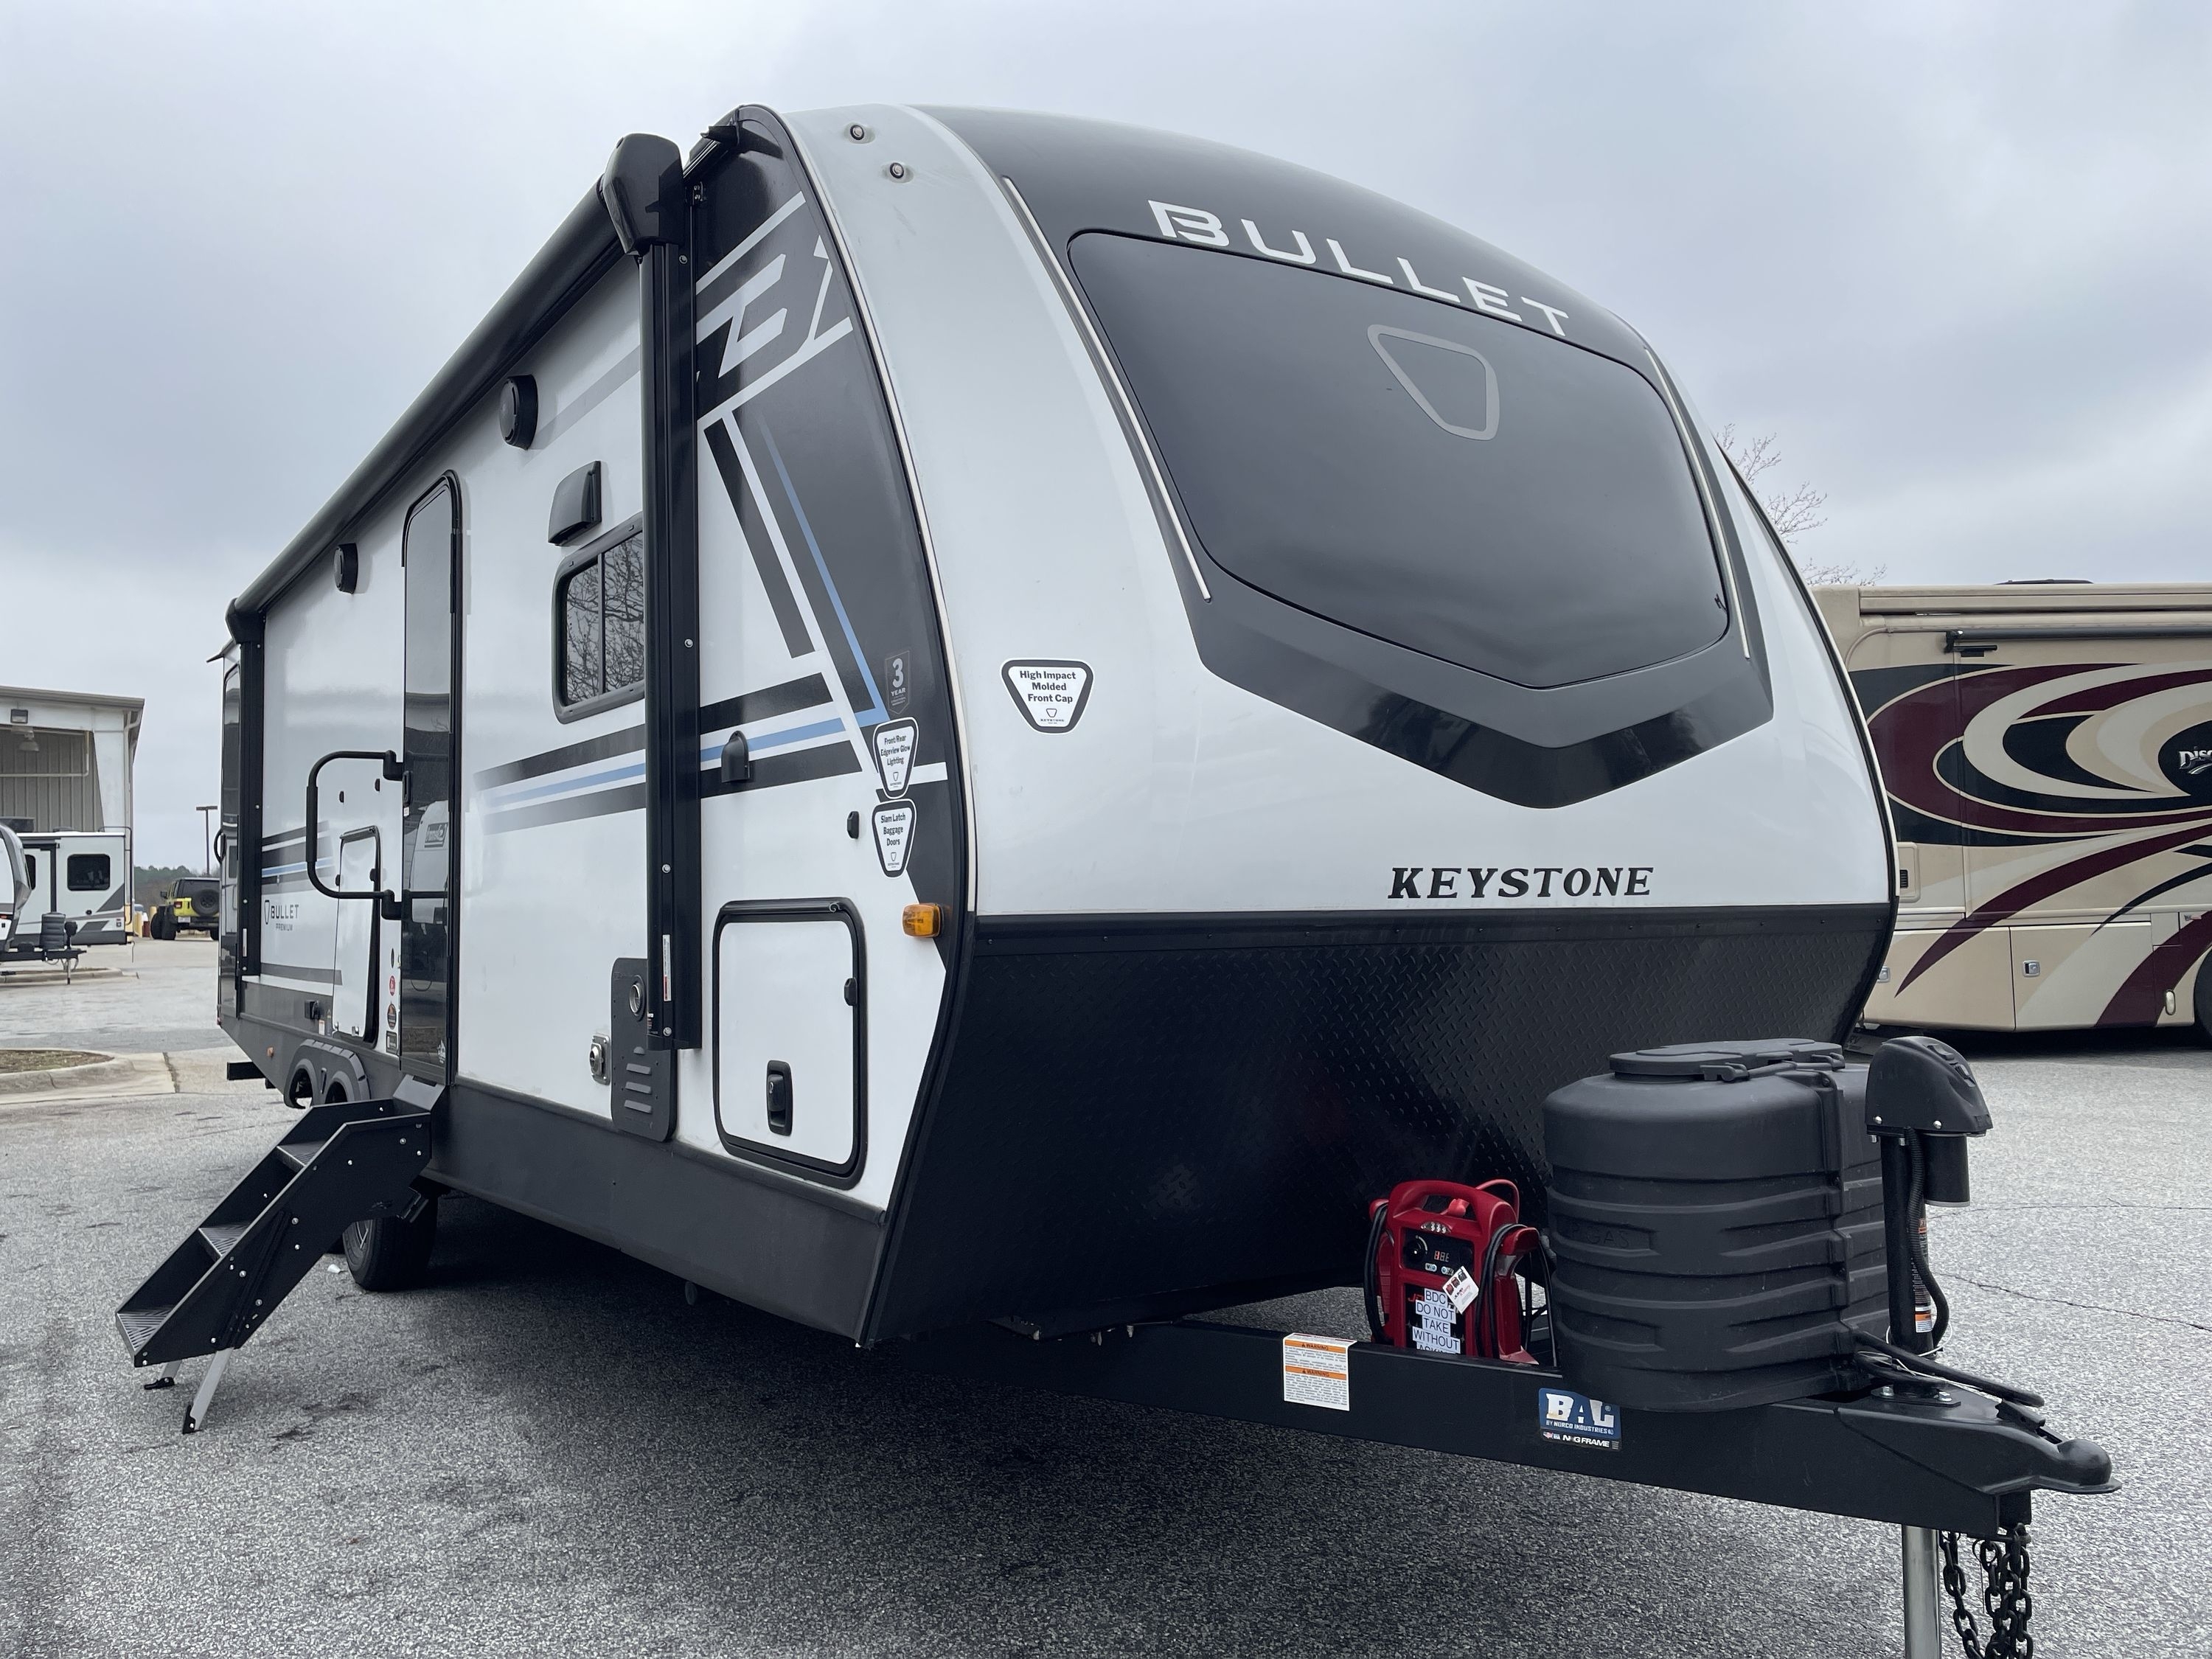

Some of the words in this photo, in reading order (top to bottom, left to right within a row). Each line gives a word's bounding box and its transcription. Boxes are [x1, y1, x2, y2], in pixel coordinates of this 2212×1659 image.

[1148, 200, 1568, 336] BULLET
[892, 658, 904, 688] 3
[1020, 670, 1042, 680] High
[1043, 671, 1077, 681] Impact
[891, 687, 907, 697] YEAR
[1032, 682, 1067, 691] Molded
[1028, 694, 1053, 702] Front
[1054, 694, 1074, 703] Cap
[880, 815, 892, 824] Slam
[892, 813, 906, 822] Latch
[883, 827, 904, 835] Baggage
[886, 838, 900, 846] Doors
[1388, 867, 1654, 900] KEYSTONE
[271, 904, 299, 919] BULLET
[1425, 1290, 1447, 1305] BDC
[1416, 1301, 1431, 1315] DO
[1433, 1307, 1455, 1321] NOT
[1423, 1317, 1450, 1334] TAKE
[1413, 1327, 1459, 1351] WITHOUT
[1307, 1369, 1329, 1377] WARNING
[1554, 1420, 1573, 1429] NORCO
[1573, 1424, 1608, 1435] INDUSTRIES
